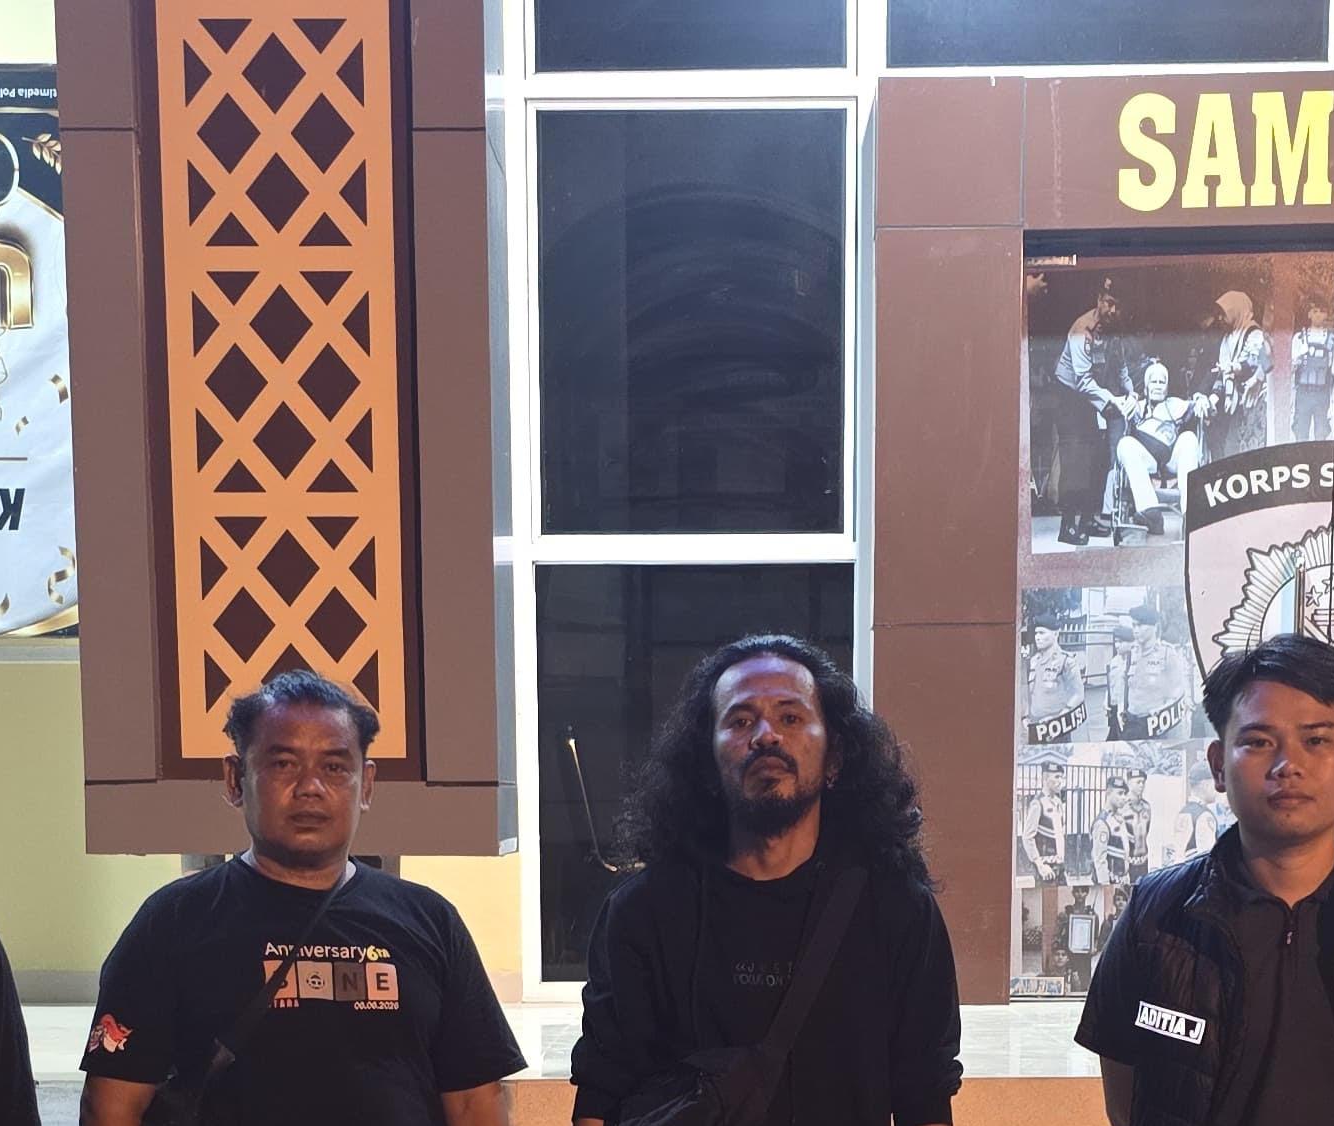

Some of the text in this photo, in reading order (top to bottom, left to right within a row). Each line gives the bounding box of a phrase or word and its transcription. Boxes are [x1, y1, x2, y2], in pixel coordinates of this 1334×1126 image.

[1203, 464, 1310, 507] KORPS
[1036, 703, 1086, 741] POLISI
[265, 942, 367, 963] Aniversary
[1139, 1006, 1202, 1039] ADITIA J
